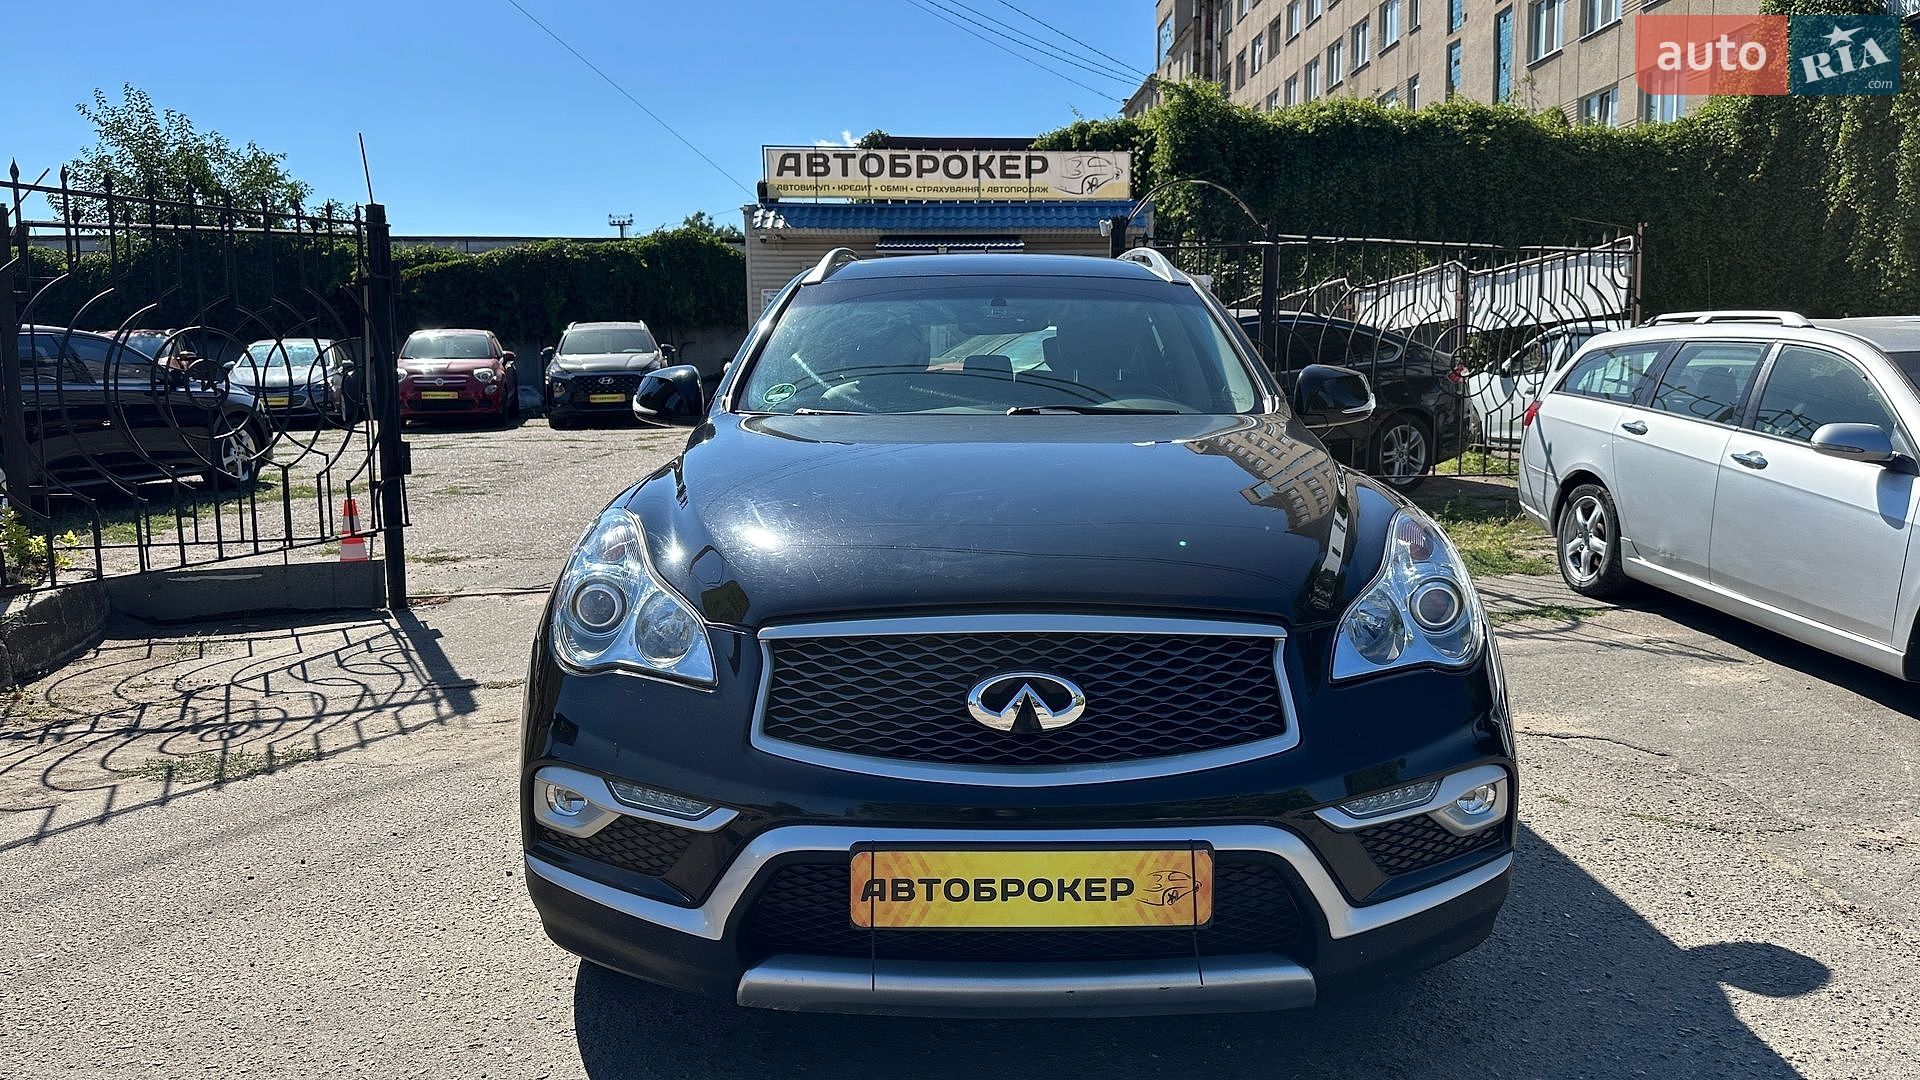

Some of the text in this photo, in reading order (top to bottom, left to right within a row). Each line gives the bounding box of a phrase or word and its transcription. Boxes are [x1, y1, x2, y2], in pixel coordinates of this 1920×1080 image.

[776, 153, 1049, 179] АВТОБРОКЕР
[776, 184, 830, 192] АВТОВИКУП
[880, 185, 908, 193] ОБМІН
[915, 186, 980, 194] СТРАХУВАННЯ
[987, 186, 1049, 194] АВТОПРОДАЖ
[860, 878, 1136, 902] АВТОБРОКЕР
